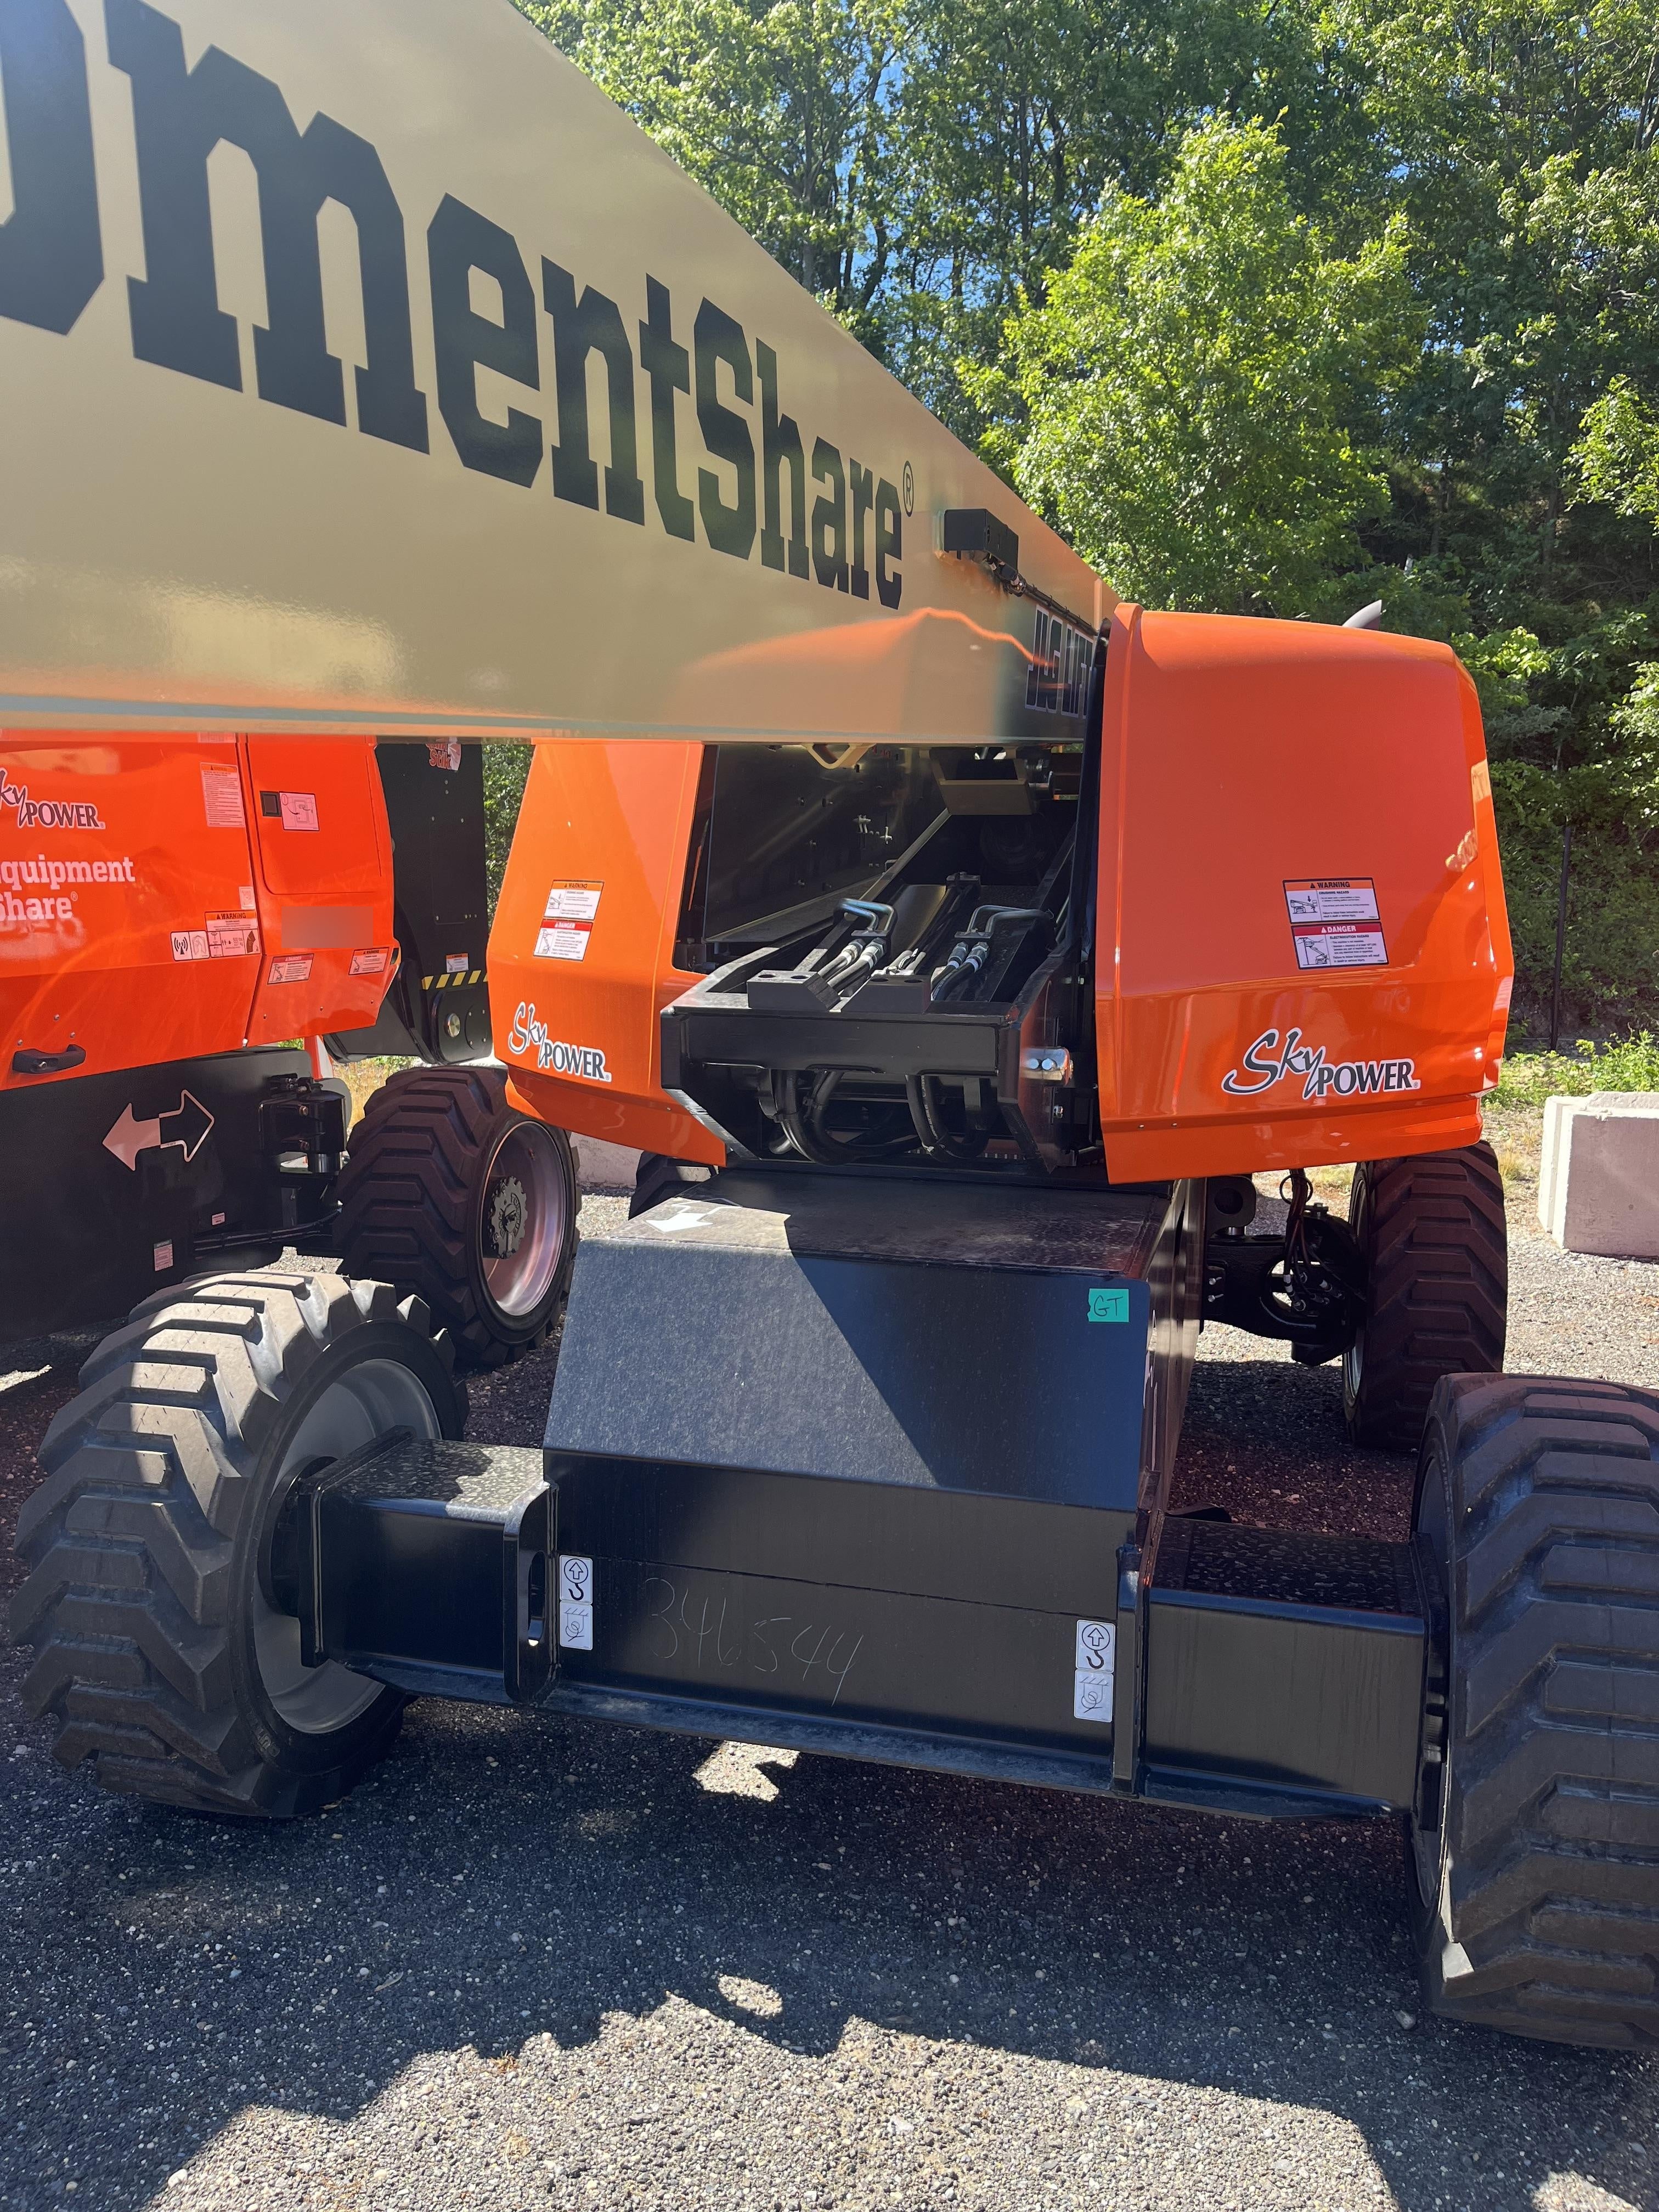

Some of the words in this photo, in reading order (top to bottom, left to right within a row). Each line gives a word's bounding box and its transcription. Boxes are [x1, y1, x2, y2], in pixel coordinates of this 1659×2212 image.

[25, 802, 99, 828] POWER
[0, 854, 136, 890] quipment
[509, 1004, 546, 1066] Sky
[544, 1042, 605, 1079] POWER
[1222, 1030, 1323, 1098] Sky
[1317, 1060, 1413, 1095] POWER
[1093, 1295, 1124, 1317] GT
